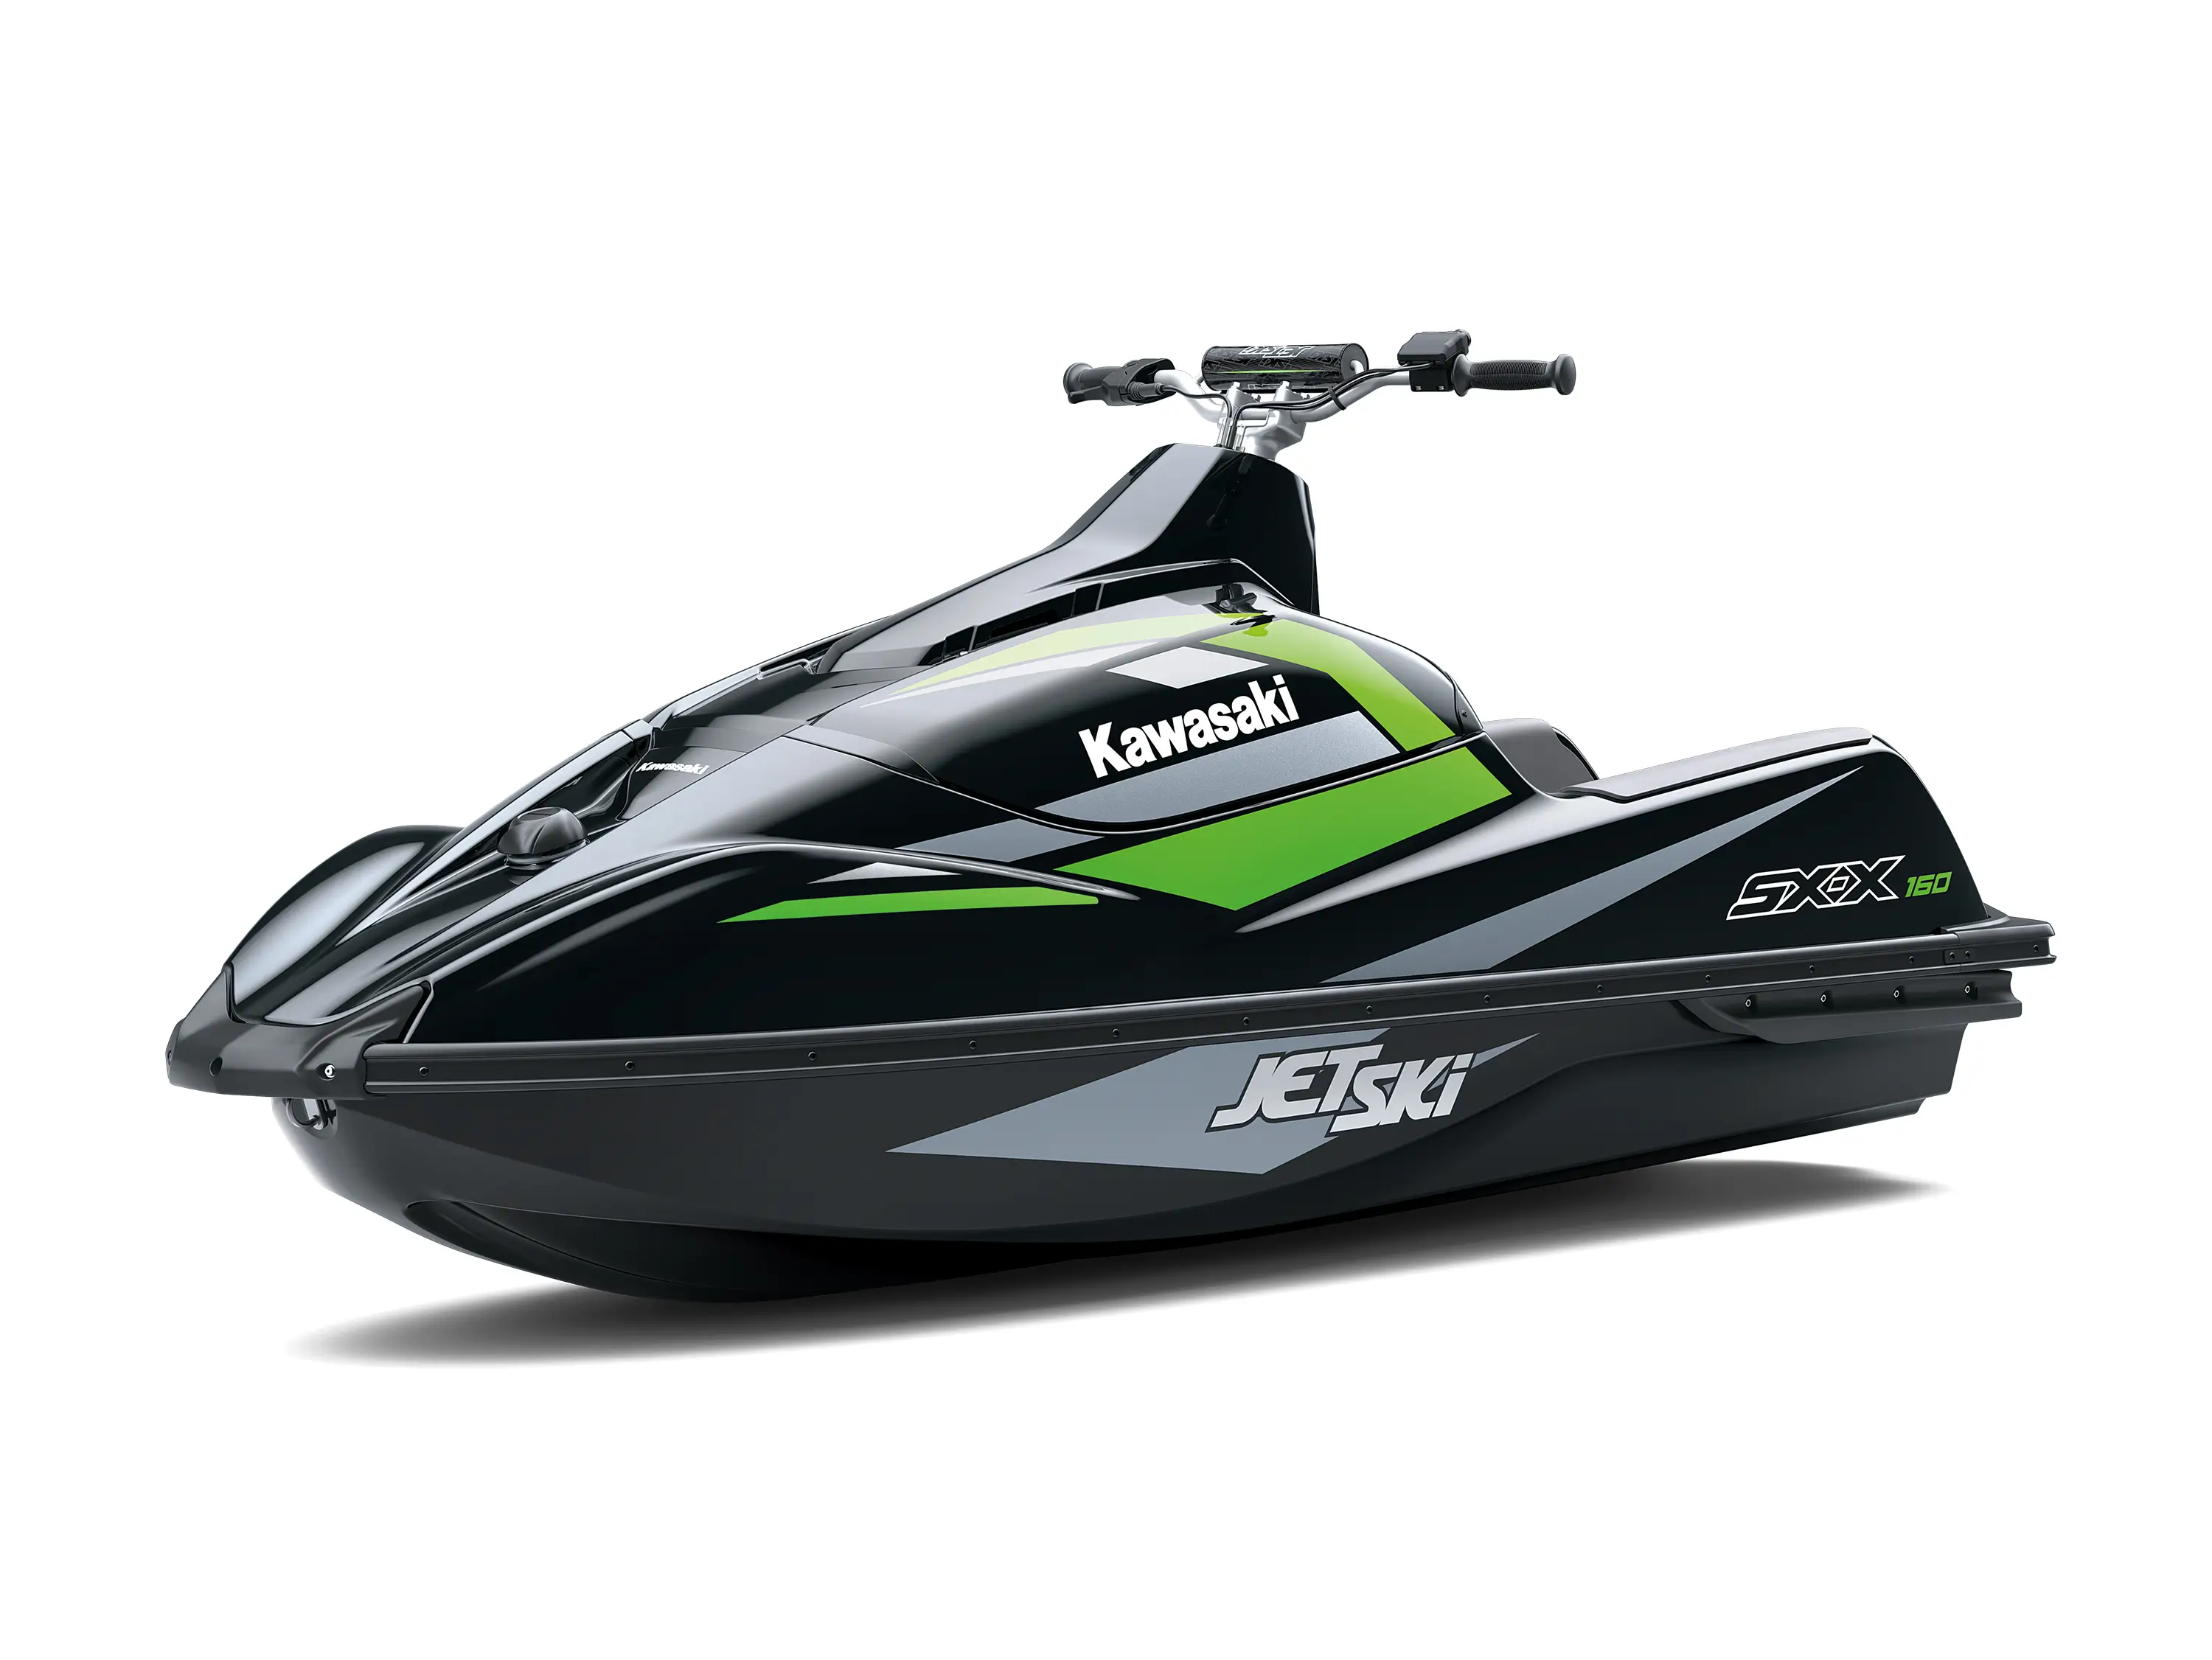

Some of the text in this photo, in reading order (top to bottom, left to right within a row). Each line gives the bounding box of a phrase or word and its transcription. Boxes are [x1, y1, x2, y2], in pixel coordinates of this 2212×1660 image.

[1078, 674, 1300, 778] Kawasaki
[636, 761, 710, 775] Kawasaki
[1905, 871, 1952, 898] 160
[1210, 1044, 1384, 1129] JET
